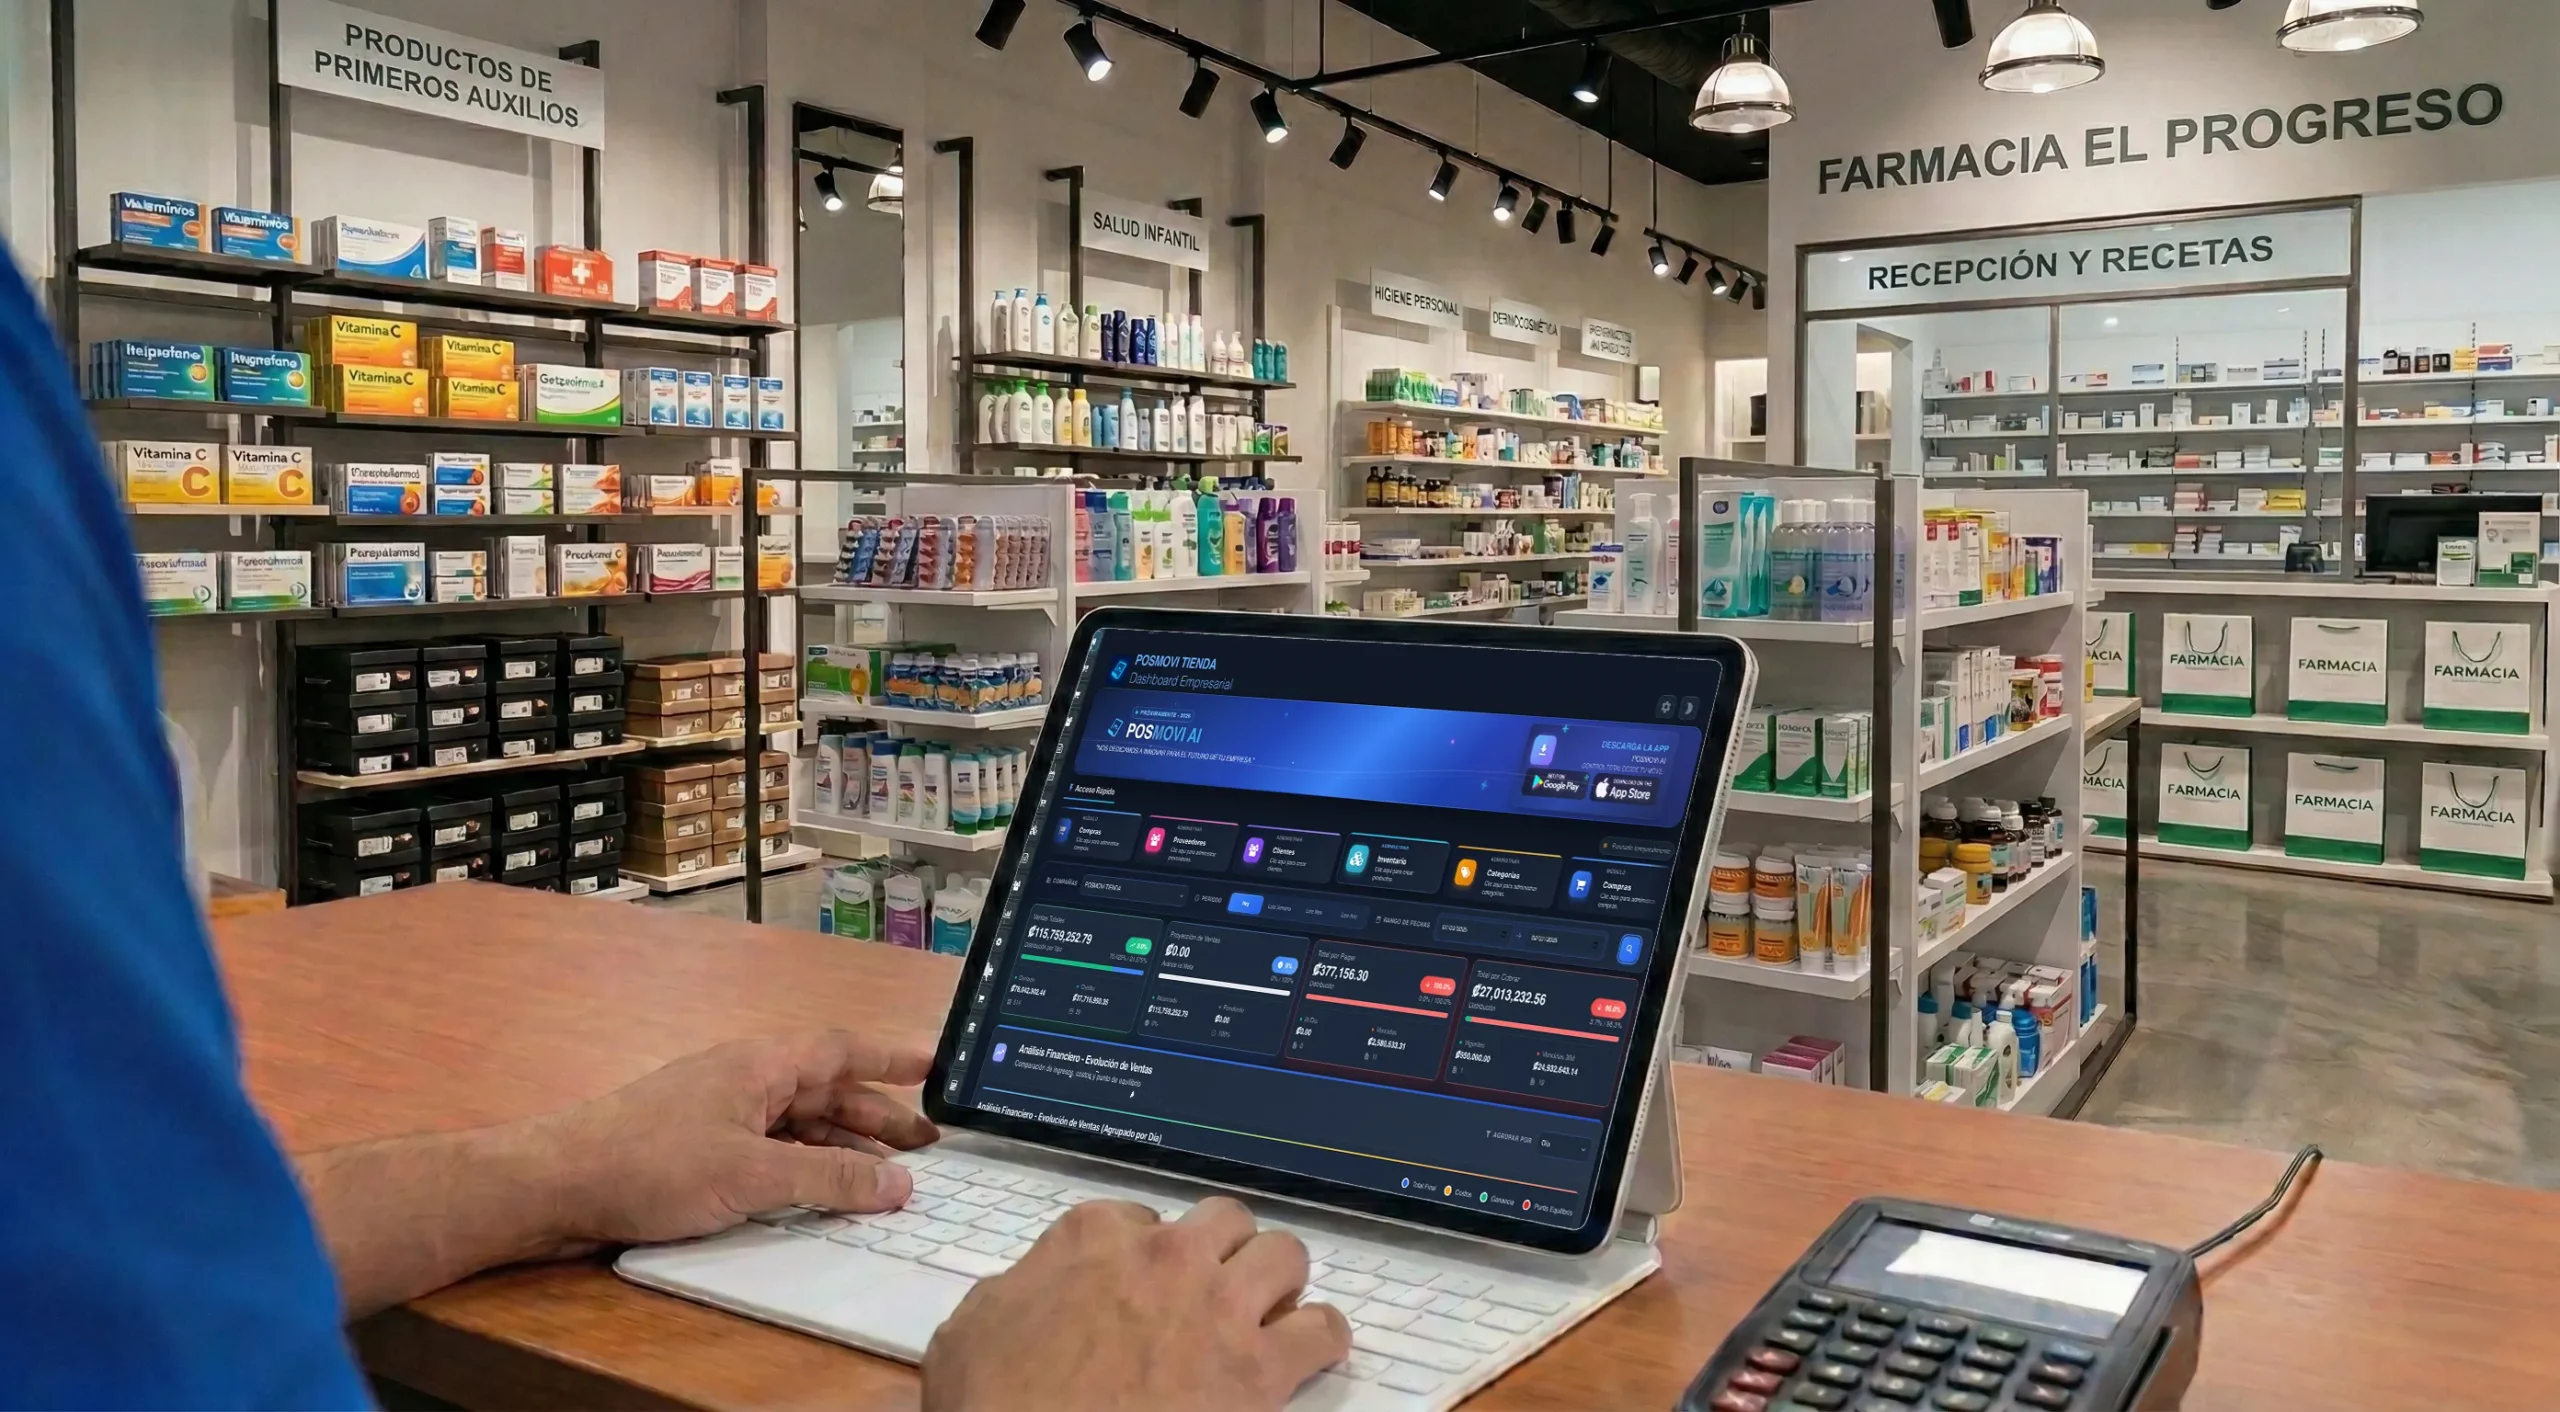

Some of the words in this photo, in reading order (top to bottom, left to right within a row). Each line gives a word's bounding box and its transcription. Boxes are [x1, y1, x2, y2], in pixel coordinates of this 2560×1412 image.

[345, 23, 513, 83] PRODUCTOS
[520, 61, 552, 94] DE
[315, 50, 459, 102] PRIMEROS
[466, 83, 579, 128] AUXILIOS
[1818, 134, 2068, 194] FARMACIA
[2085, 126, 2147, 167] EL
[2166, 83, 2503, 159] PROGRESO
[1094, 211, 1140, 237] SALUD
[1144, 224, 1200, 251] INFANTIL
[1868, 249, 2057, 290] RECEPCIÓN
[2069, 250, 2092, 275] Y
[2102, 235, 2273, 274] RECETAS
[1375, 285, 1412, 306] HIGIENE
[1414, 296, 1460, 316] PERSONAL
[336, 321, 389, 336] Vitamina
[391, 325, 401, 338] C
[447, 340, 491, 354] Vitamina
[492, 343, 501, 355] C
[348, 370, 402, 385] Vitamina
[404, 372, 413, 386] C
[452, 381, 495, 394] Vitamina
[497, 384, 506, 395] C
[133, 447, 191, 460] Vitamina
[196, 449, 206, 461] C
[233, 451, 287, 464] Vitamina
[291, 452, 301, 463] C
[182, 466, 211, 496] C
[279, 470, 304, 498] C
[1135, 654, 1180, 668] POSMOVI
[1182, 657, 1216, 670] TIENDA
[2091, 651, 2122, 661] ACIA
[2170, 654, 2244, 666] FARMACIA
[2299, 658, 2377, 673] FARMACIA
[2434, 664, 2520, 679] FARMACIA
[1129, 672, 1179, 686] Dashboard
[1180, 675, 1234, 690] Empresarial
[1126, 723, 1186, 742] POSMOVI
[1187, 728, 1202, 743] AI
[1602, 741, 1640, 750] DESCARGA
[1543, 780, 1565, 791] Google
[1566, 782, 1579, 792] Play
[2083, 776, 2125, 789] MACIA
[1609, 787, 1627, 798] App
[1628, 788, 1650, 800] Store
[2168, 784, 2240, 800] FARMACIA
[2295, 794, 2374, 811] FARMACIA
[2430, 805, 2515, 824] FARMACIA
[1079, 827, 1101, 835] Compras
[1173, 836, 1206, 847] Proveedores
[1272, 847, 1295, 855] Clientes
[1377, 855, 1407, 865] Inventario
[1602, 881, 1632, 892] Compras
[1019, 1044, 1046, 1058] Análisis
[1046, 1048, 1080, 1063] Financiero
[1085, 1055, 1119, 1069] Evolución
[1120, 1062, 1129, 1071] de
[1130, 1062, 1153, 1075] Ventas
[977, 1102, 1001, 1113] Análisis
[1001, 1105, 1033, 1119] Financiero
[1038, 1112, 1068, 1126] Evolución
[1069, 1118, 1077, 1127] de
[1078, 1119, 1100, 1132] Ventas
[1101, 1124, 1134, 1140] (Agrupado
[1135, 1131, 1147, 1141] por
[1148, 1132, 1162, 1144] Día)
